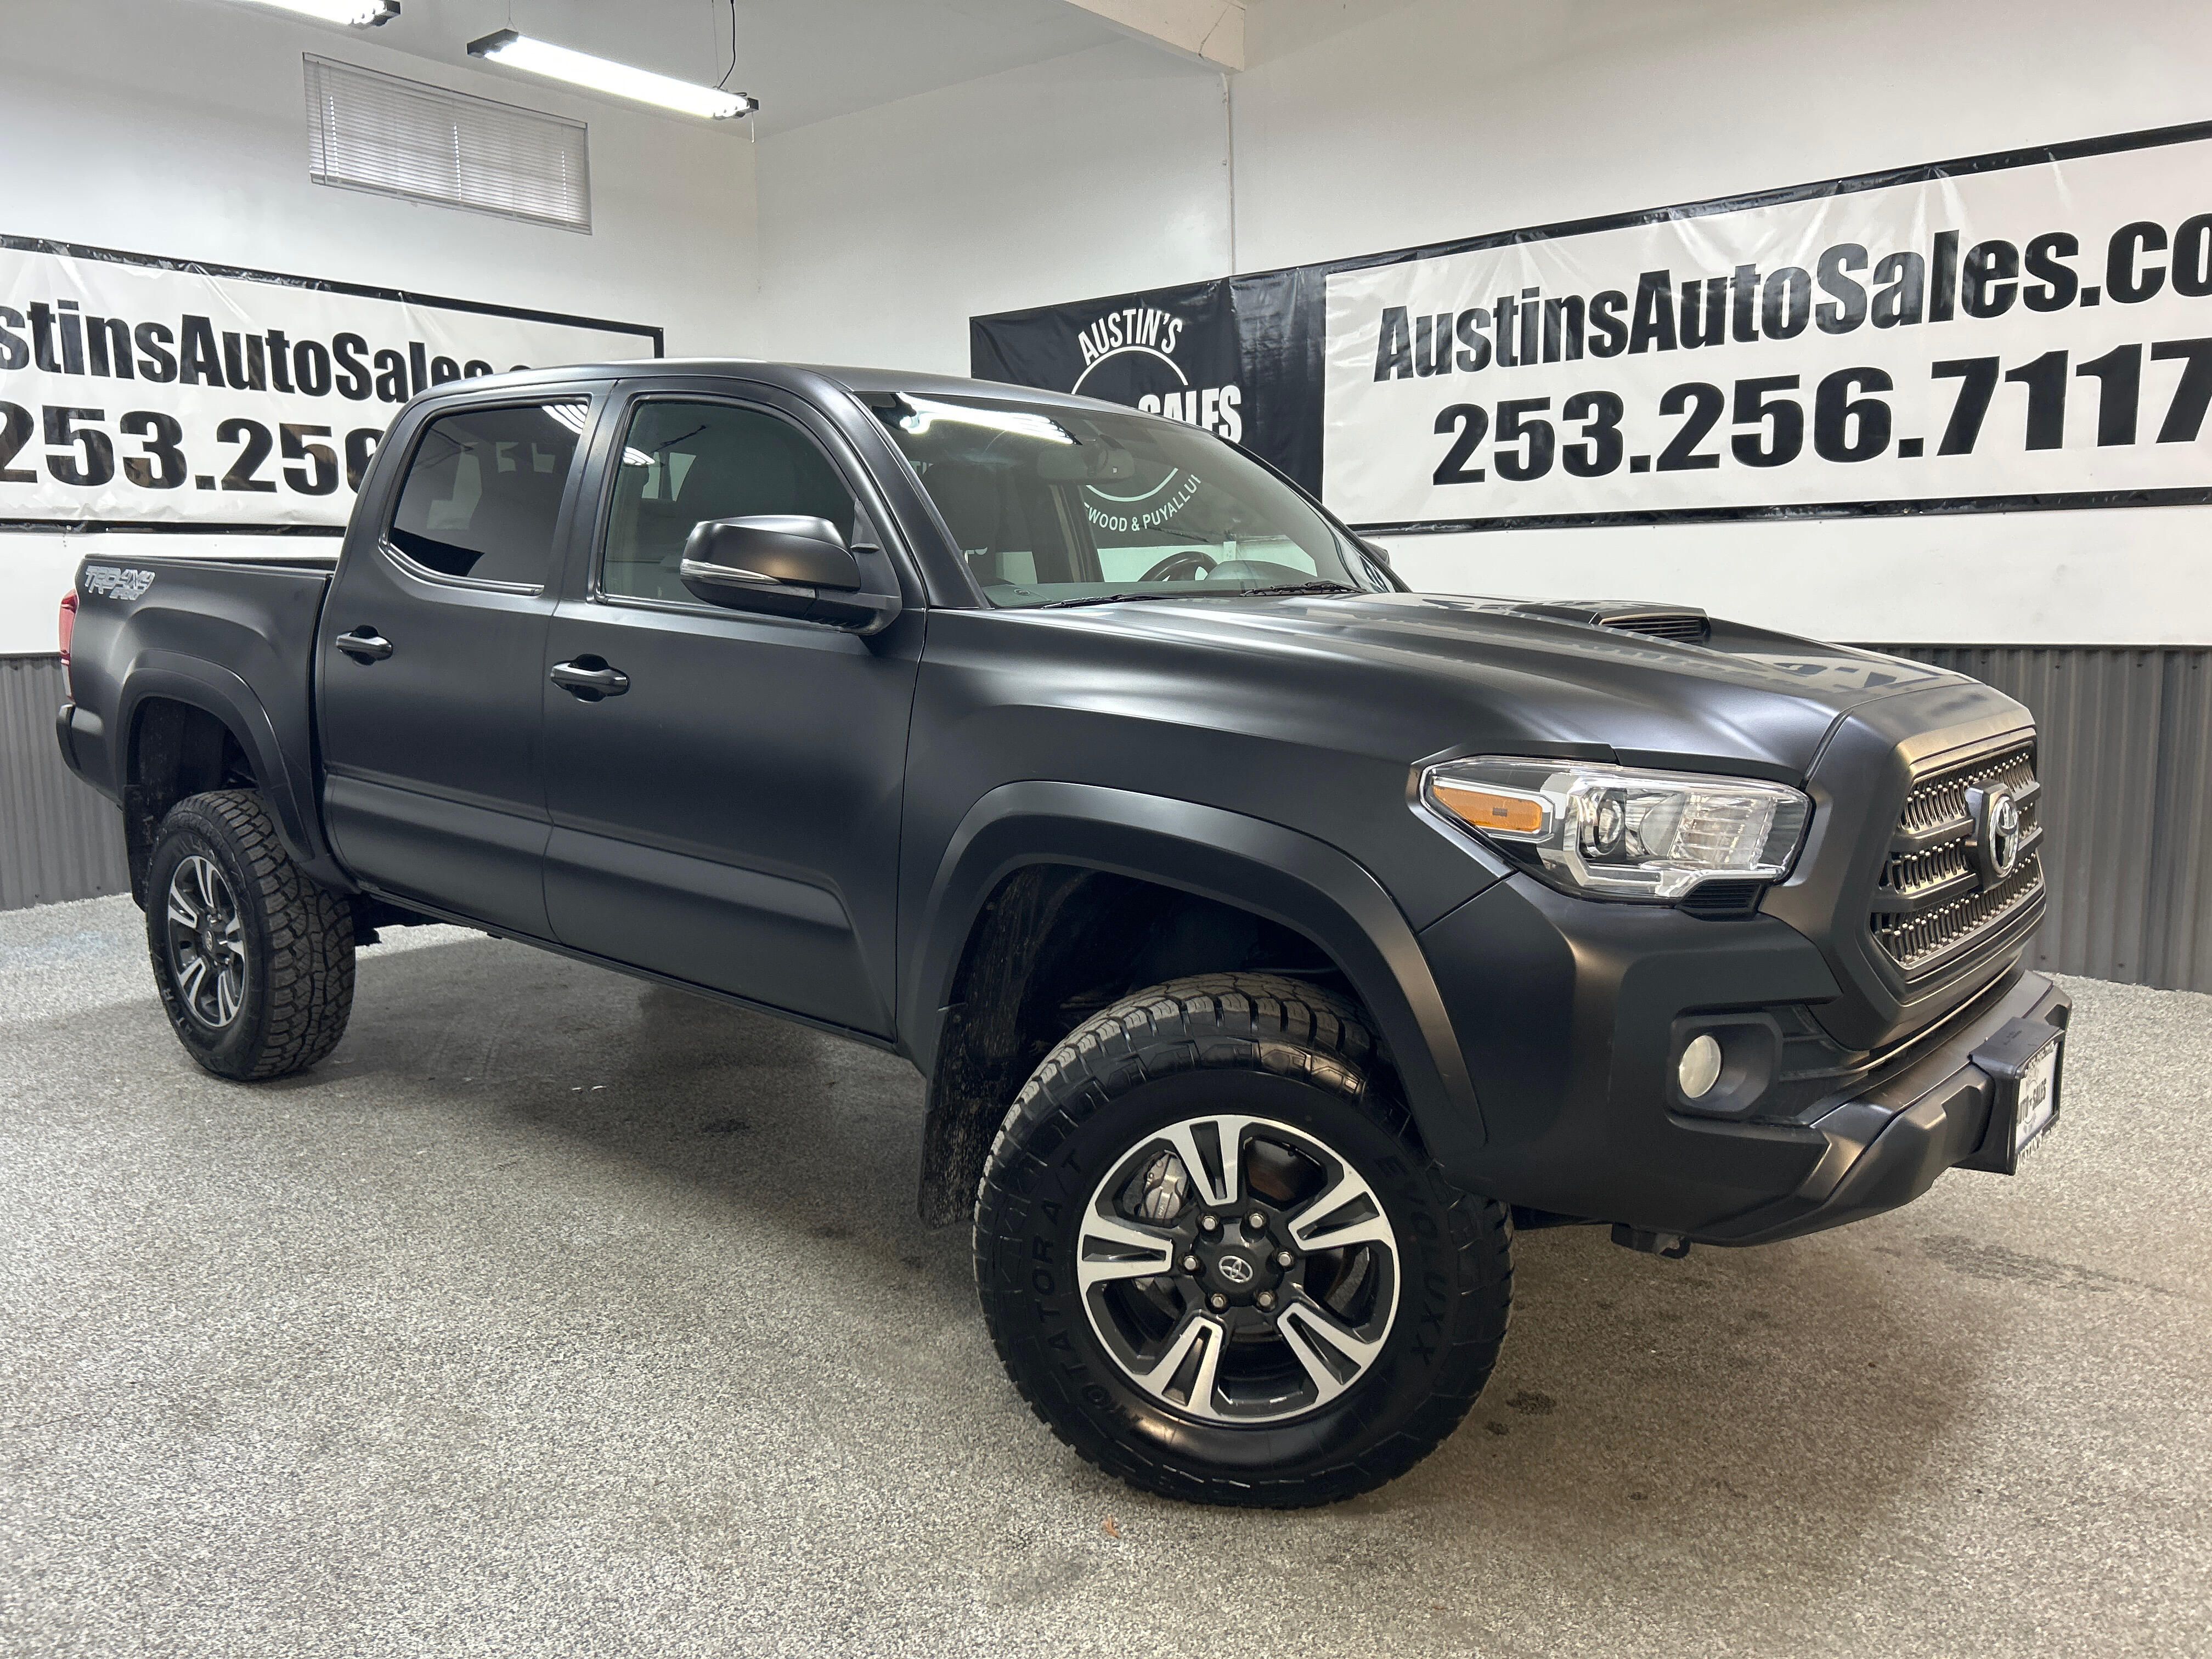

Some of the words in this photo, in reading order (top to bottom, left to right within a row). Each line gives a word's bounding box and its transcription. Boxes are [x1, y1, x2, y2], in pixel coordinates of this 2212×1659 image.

[1078, 308, 1183, 365] AUSTIN'S
[1373, 213, 2212, 382] AustinsAutoSales.co
[1433, 337, 2212, 485] 253.256.7117
[1084, 502, 1127, 532] WOOD
[1131, 517, 1140, 532] &
